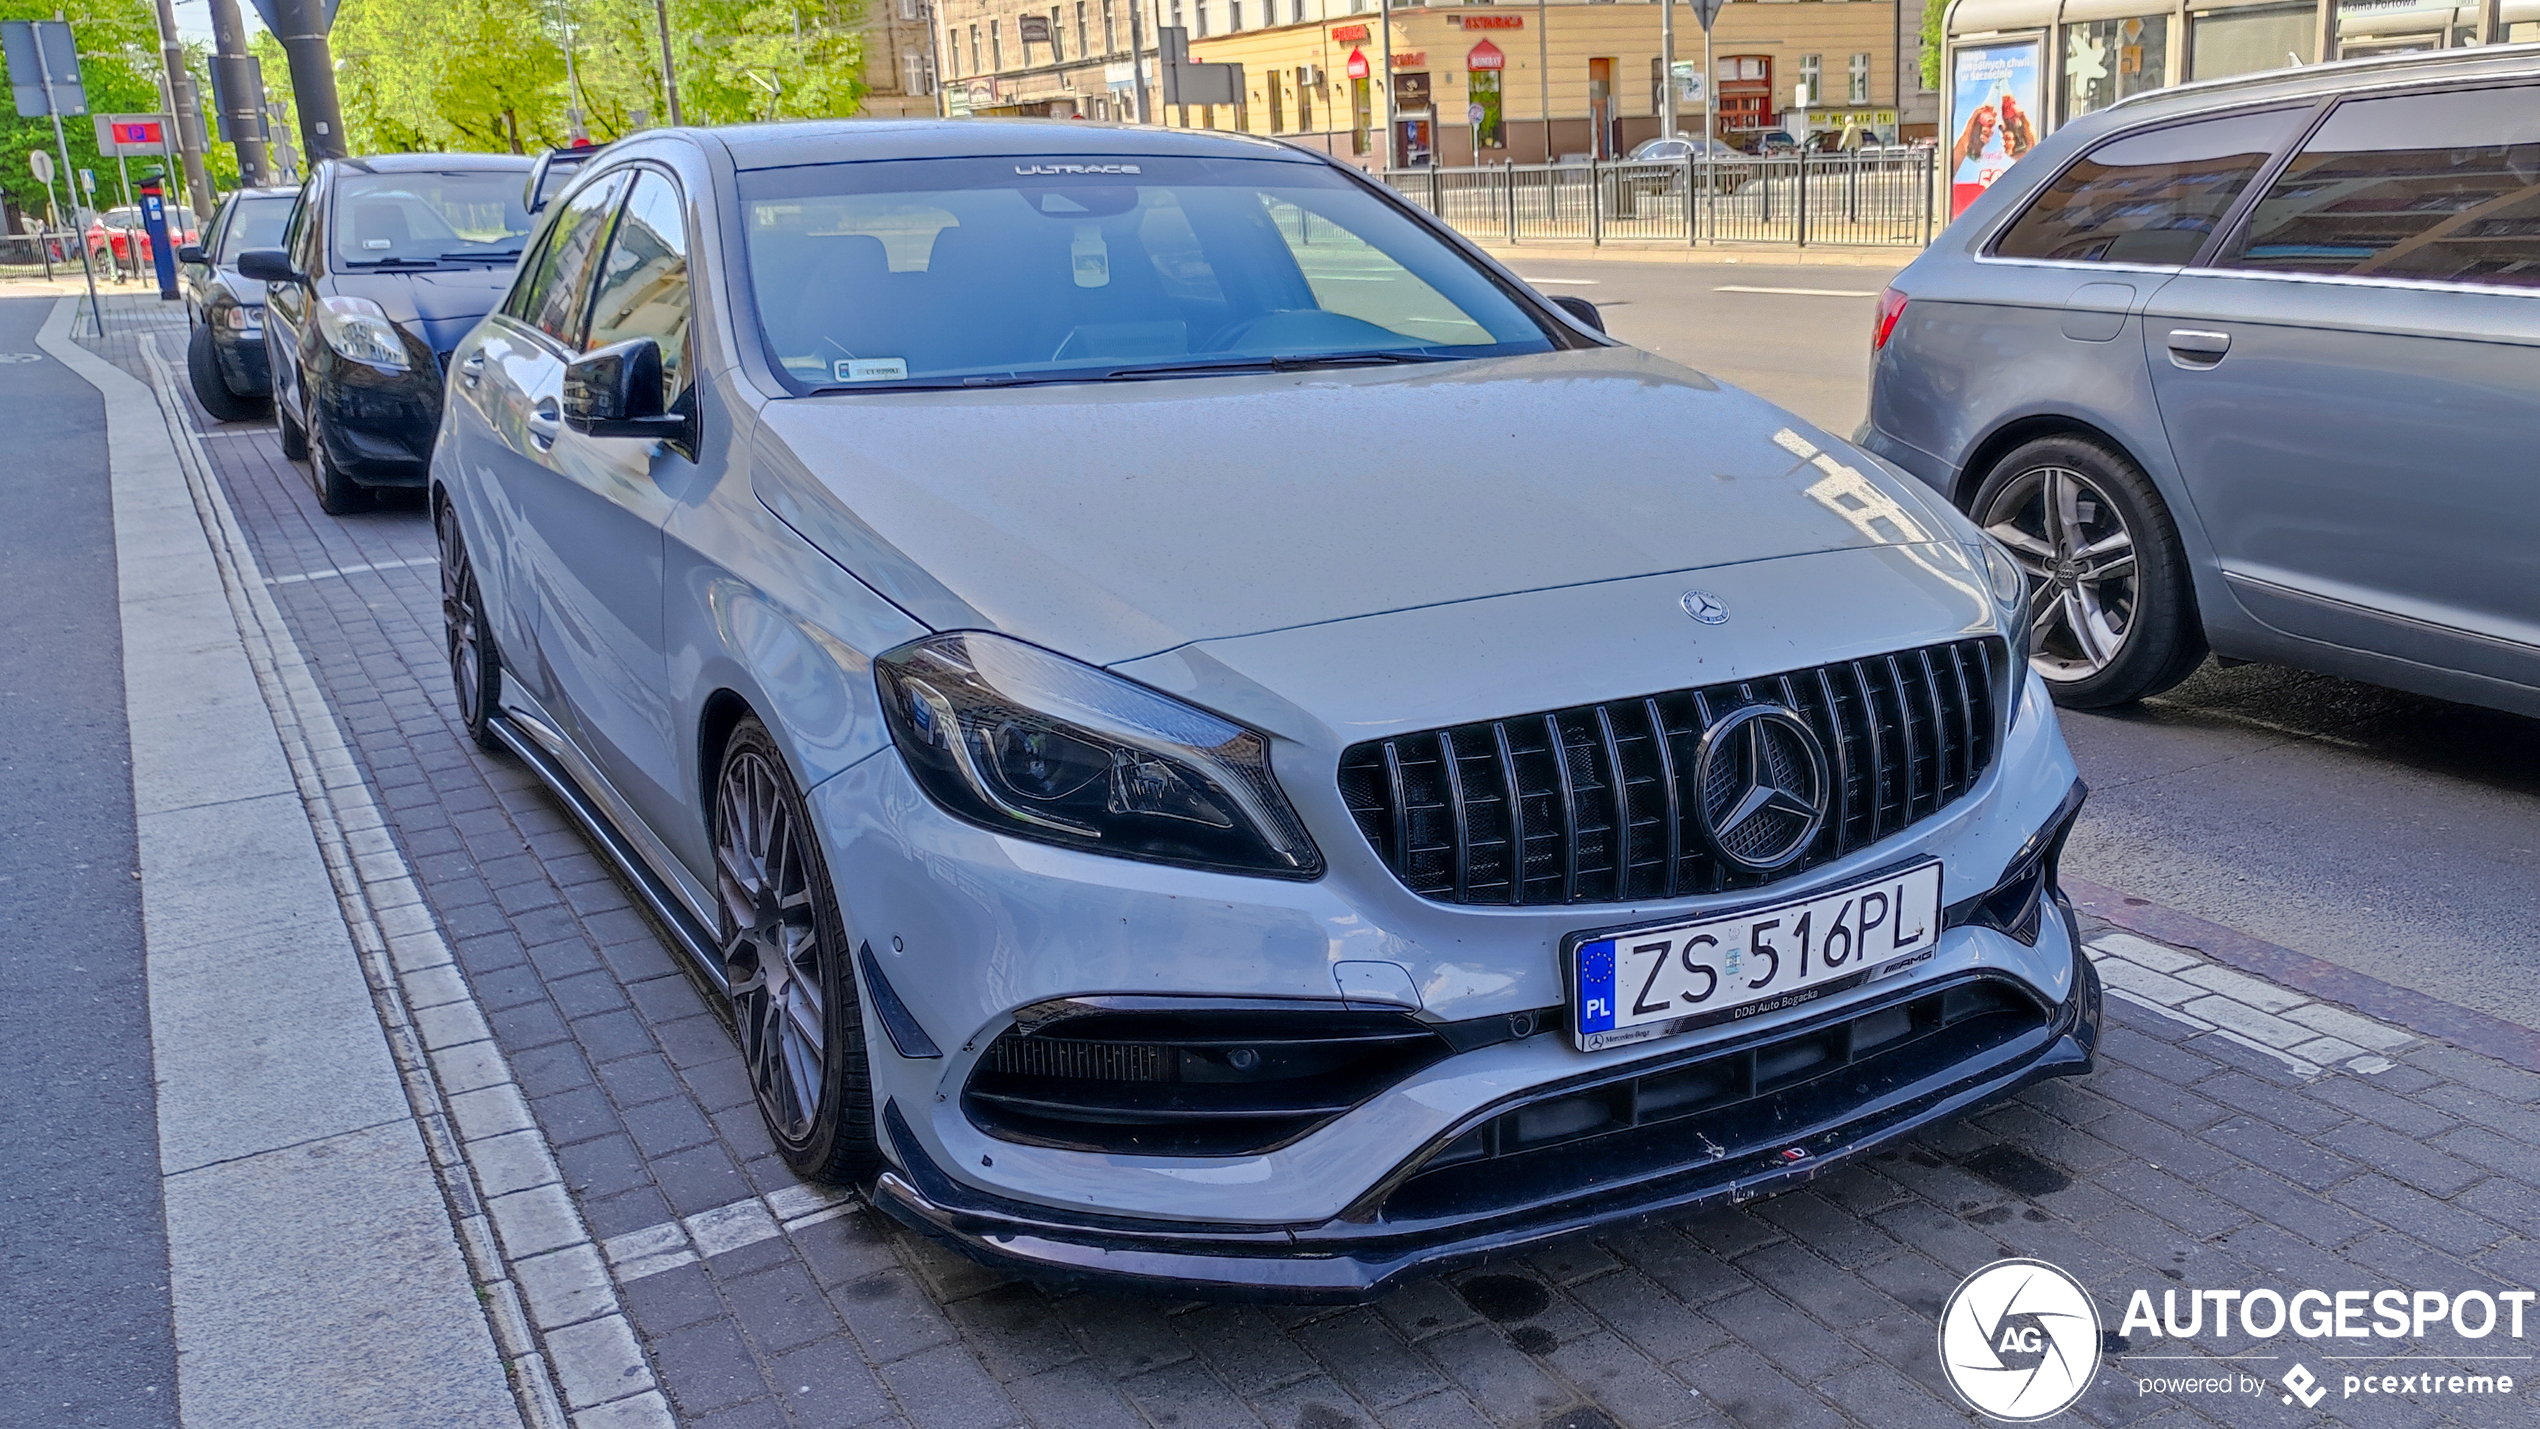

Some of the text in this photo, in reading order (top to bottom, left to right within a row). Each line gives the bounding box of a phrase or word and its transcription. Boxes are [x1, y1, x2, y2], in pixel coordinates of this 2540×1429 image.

[1014, 164, 1142, 175] ULTRACE
[1632, 884, 1920, 1016] ZS 516PL
[1586, 998, 1611, 1019] PL
[1734, 1006, 1756, 1019] DDB
[1757, 1001, 1780, 1014] Auto
